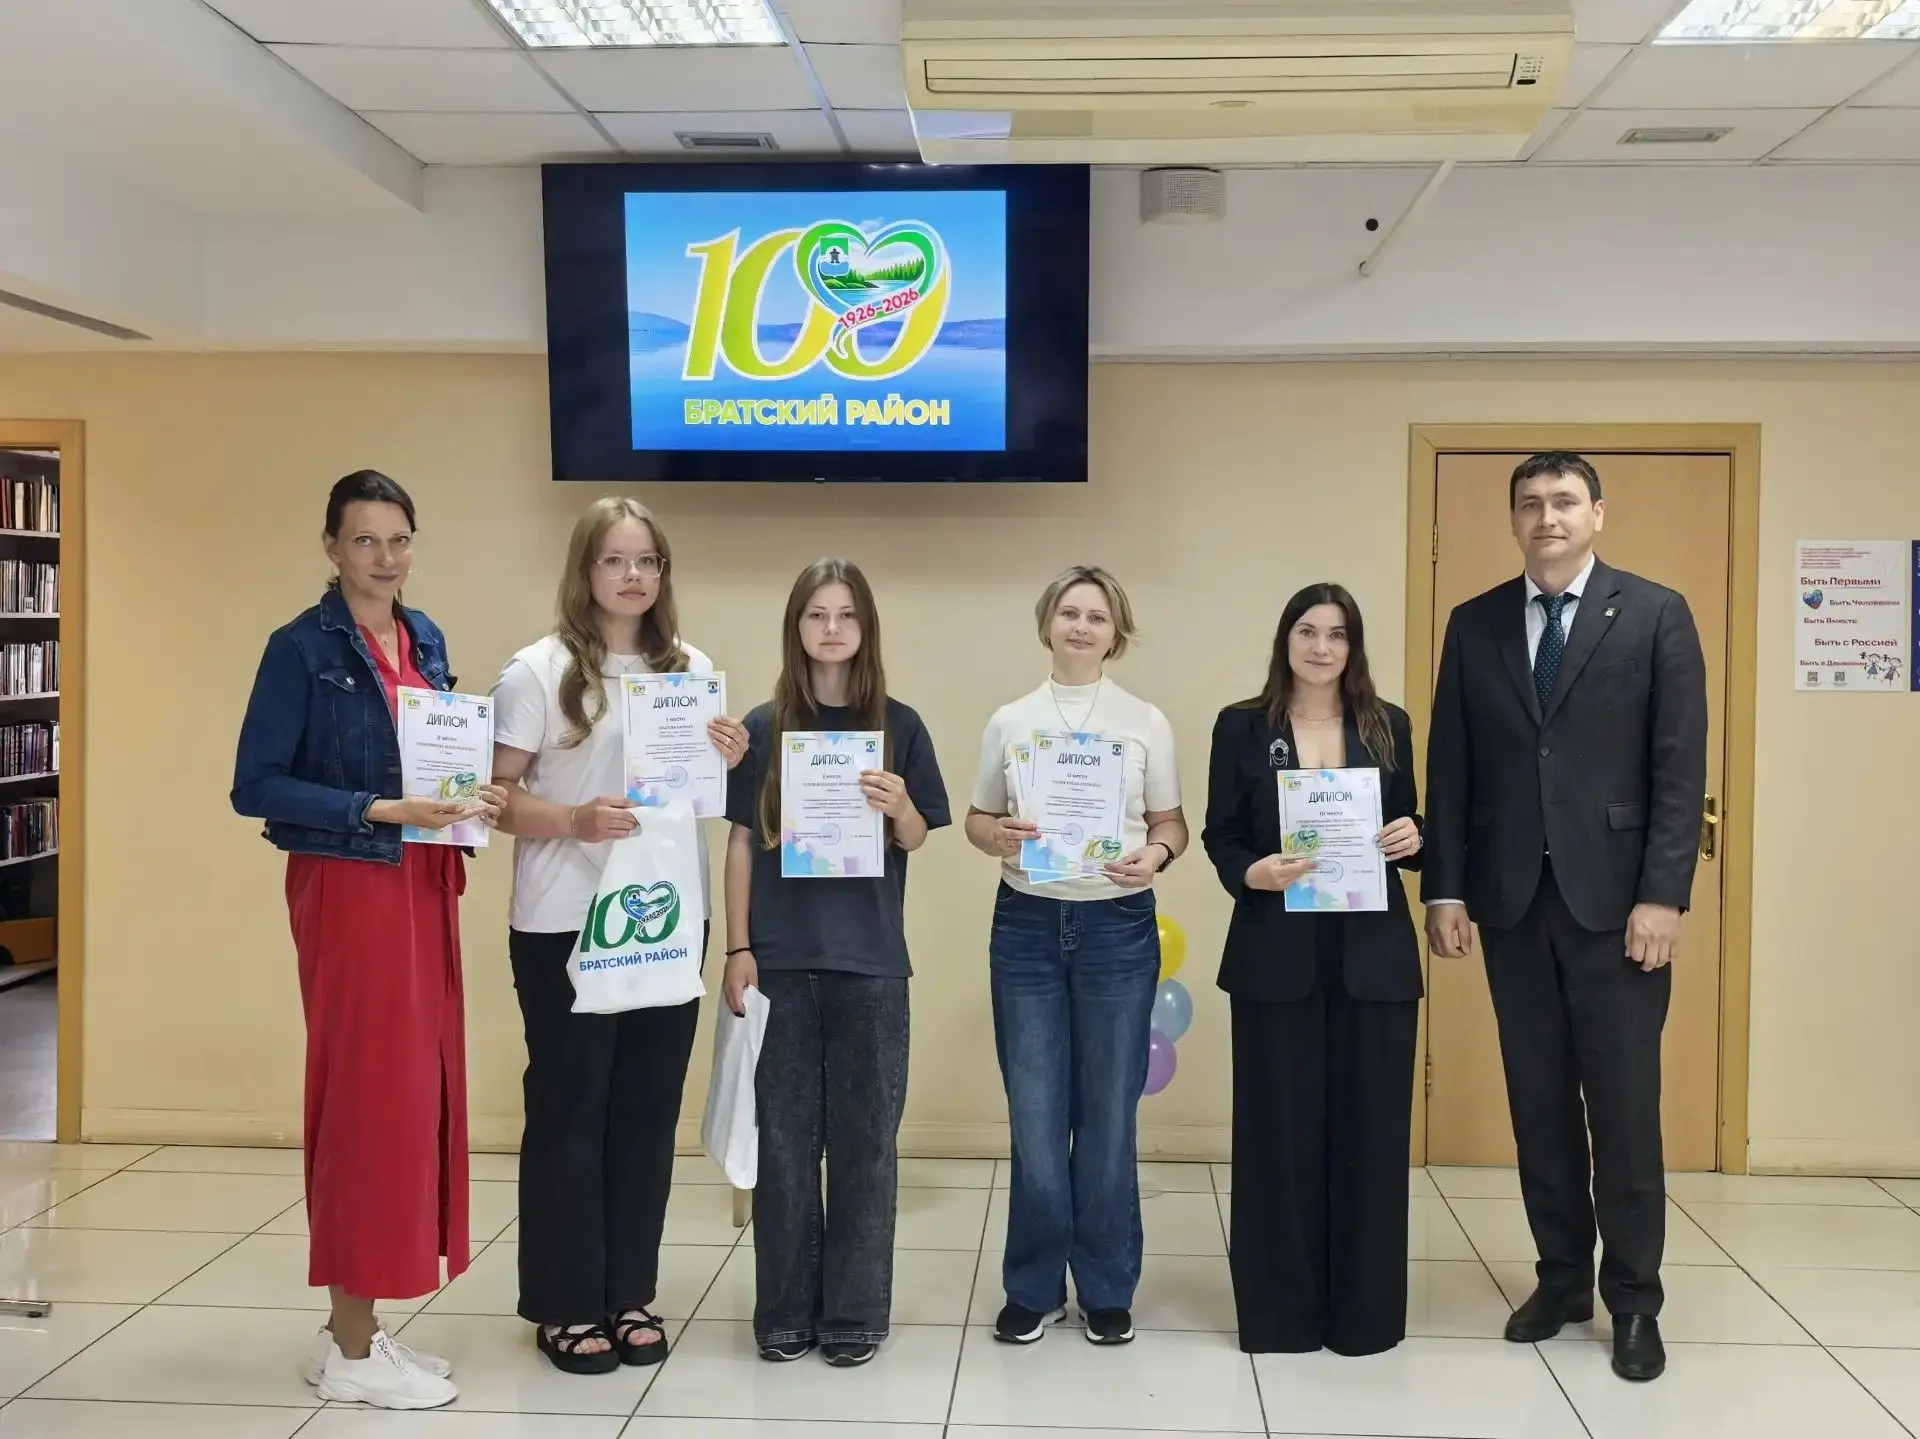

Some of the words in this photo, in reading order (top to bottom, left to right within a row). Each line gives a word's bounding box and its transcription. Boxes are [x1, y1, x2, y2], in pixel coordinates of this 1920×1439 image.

[682, 221, 951, 381] 100
[838, 287, 920, 330] 1926-2026
[684, 393, 838, 426] БРАТСКИЙ
[845, 393, 950, 426] РАЙОН
[1800, 576, 1828, 586] Быть
[1829, 576, 1881, 587] Первыми
[1814, 638, 1841, 646] Быть
[1851, 637, 1898, 647] Россией
[652, 695, 698, 709] ДИПЛОМ
[426, 713, 468, 729] ДИПЛОМ
[810, 753, 855, 767] ДИПЛОМ
[1056, 752, 1101, 767] ДИПЛОМ
[1308, 791, 1353, 804] ДИПЛОМ
[580, 884, 680, 953] 100
[580, 951, 642, 972] БРАТСКИЙ
[645, 947, 688, 963] РАЙОН
